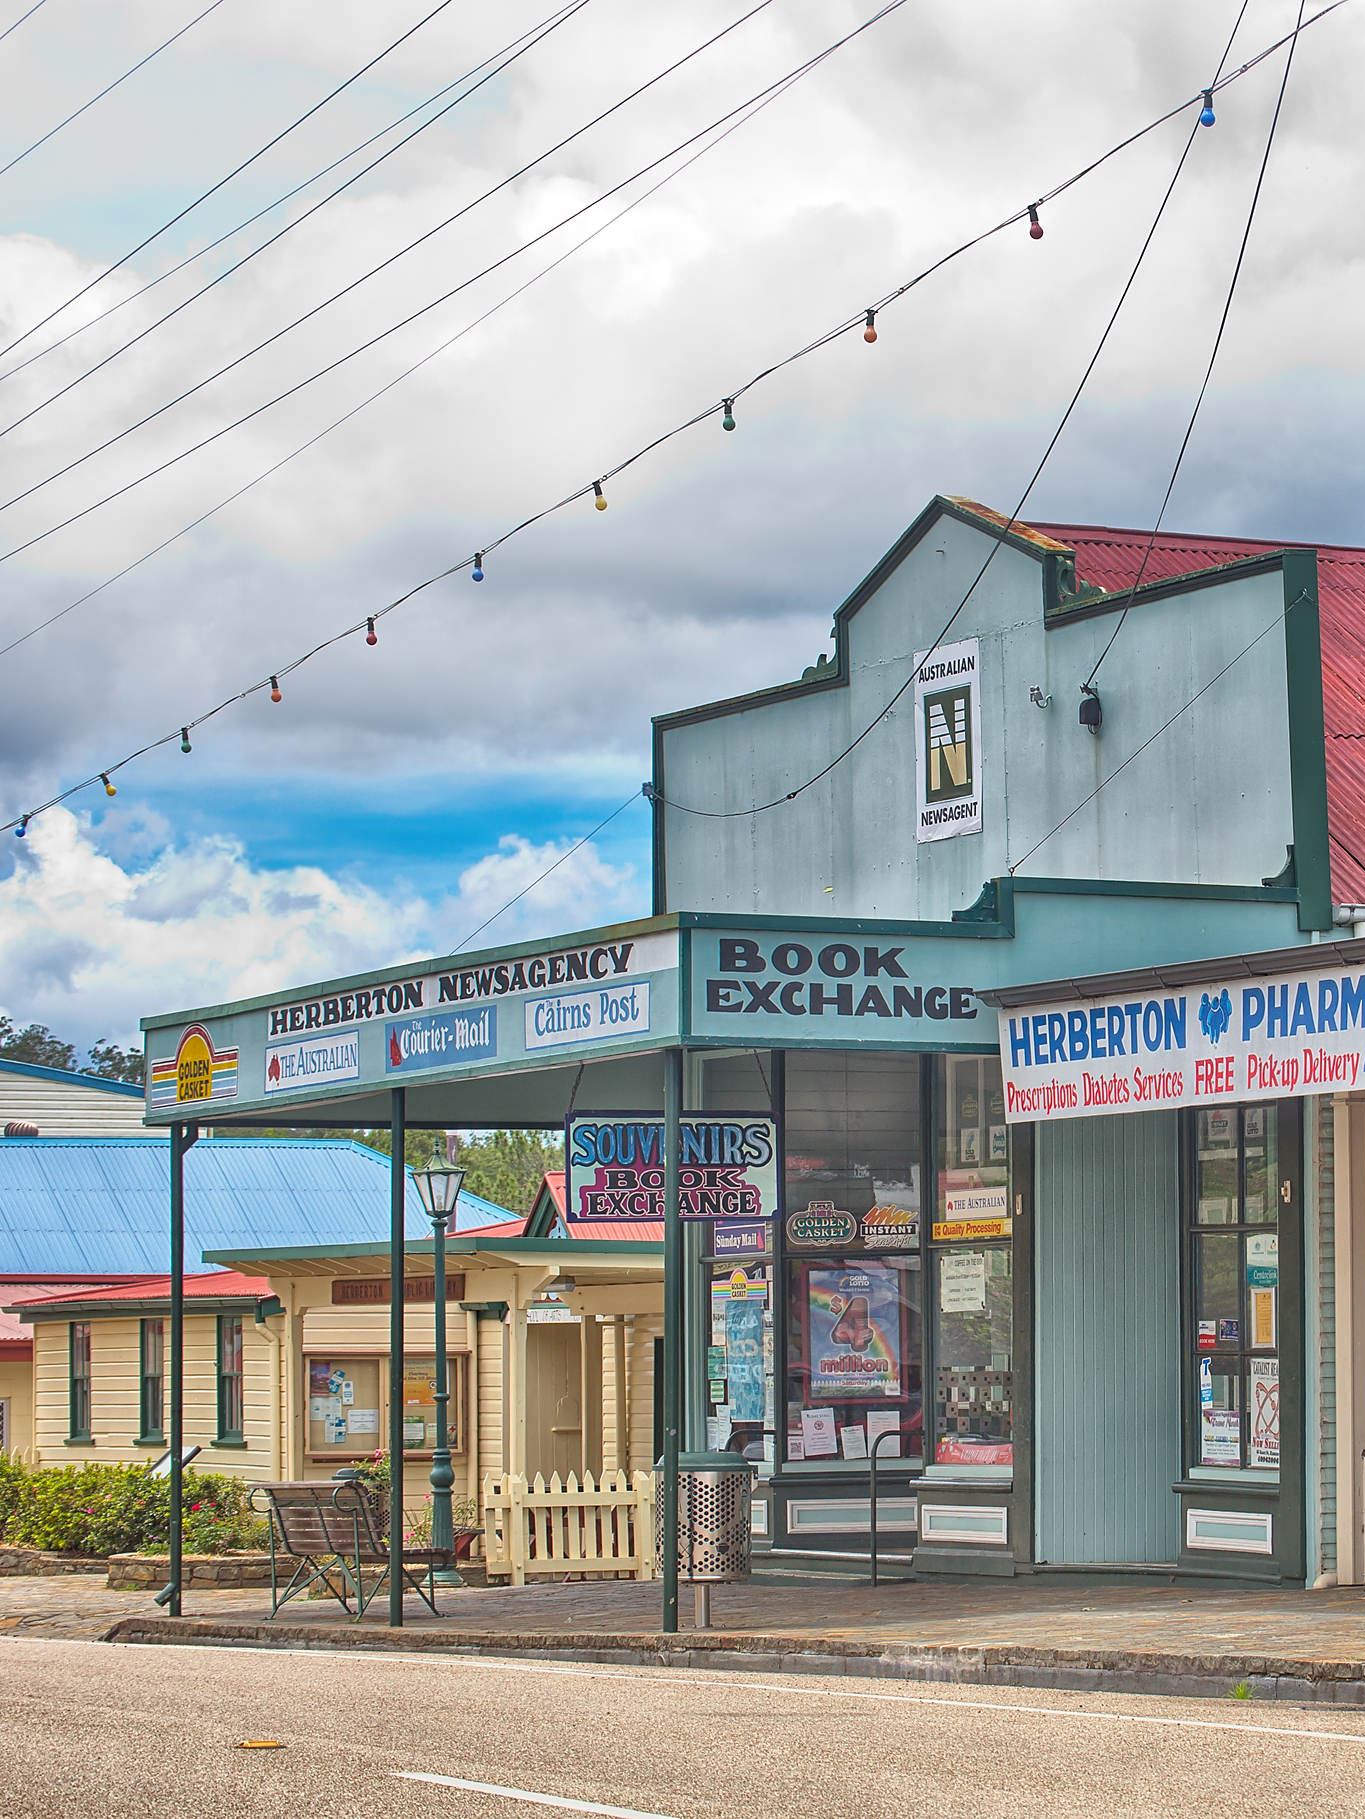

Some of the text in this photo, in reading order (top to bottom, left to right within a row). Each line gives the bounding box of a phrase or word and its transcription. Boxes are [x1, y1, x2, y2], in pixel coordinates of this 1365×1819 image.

[918, 656, 975, 683] AUSTRALIAN
[921, 802, 978, 826] NEWSAGENT
[719, 938, 909, 978] BOOK
[269, 942, 634, 1036] HERBERTON NEWSAGENCY
[706, 979, 978, 1020] EXCHANGE
[534, 991, 640, 1036] Cairns Post
[400, 1010, 491, 1060] Courier-Mail
[411, 1020, 422, 1030] The
[1009, 996, 1187, 1068] HERBERTON
[281, 1042, 358, 1078] THE AUSTRALIAN
[178, 1060, 210, 1082] GOLDEN
[1007, 1078, 1078, 1115] Prescriptions
[1083, 1069, 1130, 1106] Diabetes
[1133, 1067, 1184, 1100] Services
[1195, 1056, 1235, 1095] FREE
[1247, 1052, 1299, 1089] Pick-up
[1302, 1048, 1360, 1086] Delivery
[179, 1079, 211, 1101] CASKET
[605, 1169, 741, 1190] BOOK
[954, 1197, 1006, 1210] THE AUSTRALIAN
[797, 1218, 845, 1227] GOLDEN
[797, 1228, 846, 1237] CASKET
[864, 1225, 913, 1234] INSTANT
[943, 1222, 1001, 1236] Quality Processing
[716, 1233, 757, 1248] Sunday Mail
[1253, 1269, 1277, 1280] Centrelink
[341, 1285, 383, 1299] HERBERTON
[404, 1283, 423, 1297] UBLIC
[731, 1282, 746, 1290] GOLDEN
[820, 1354, 889, 1373] million
